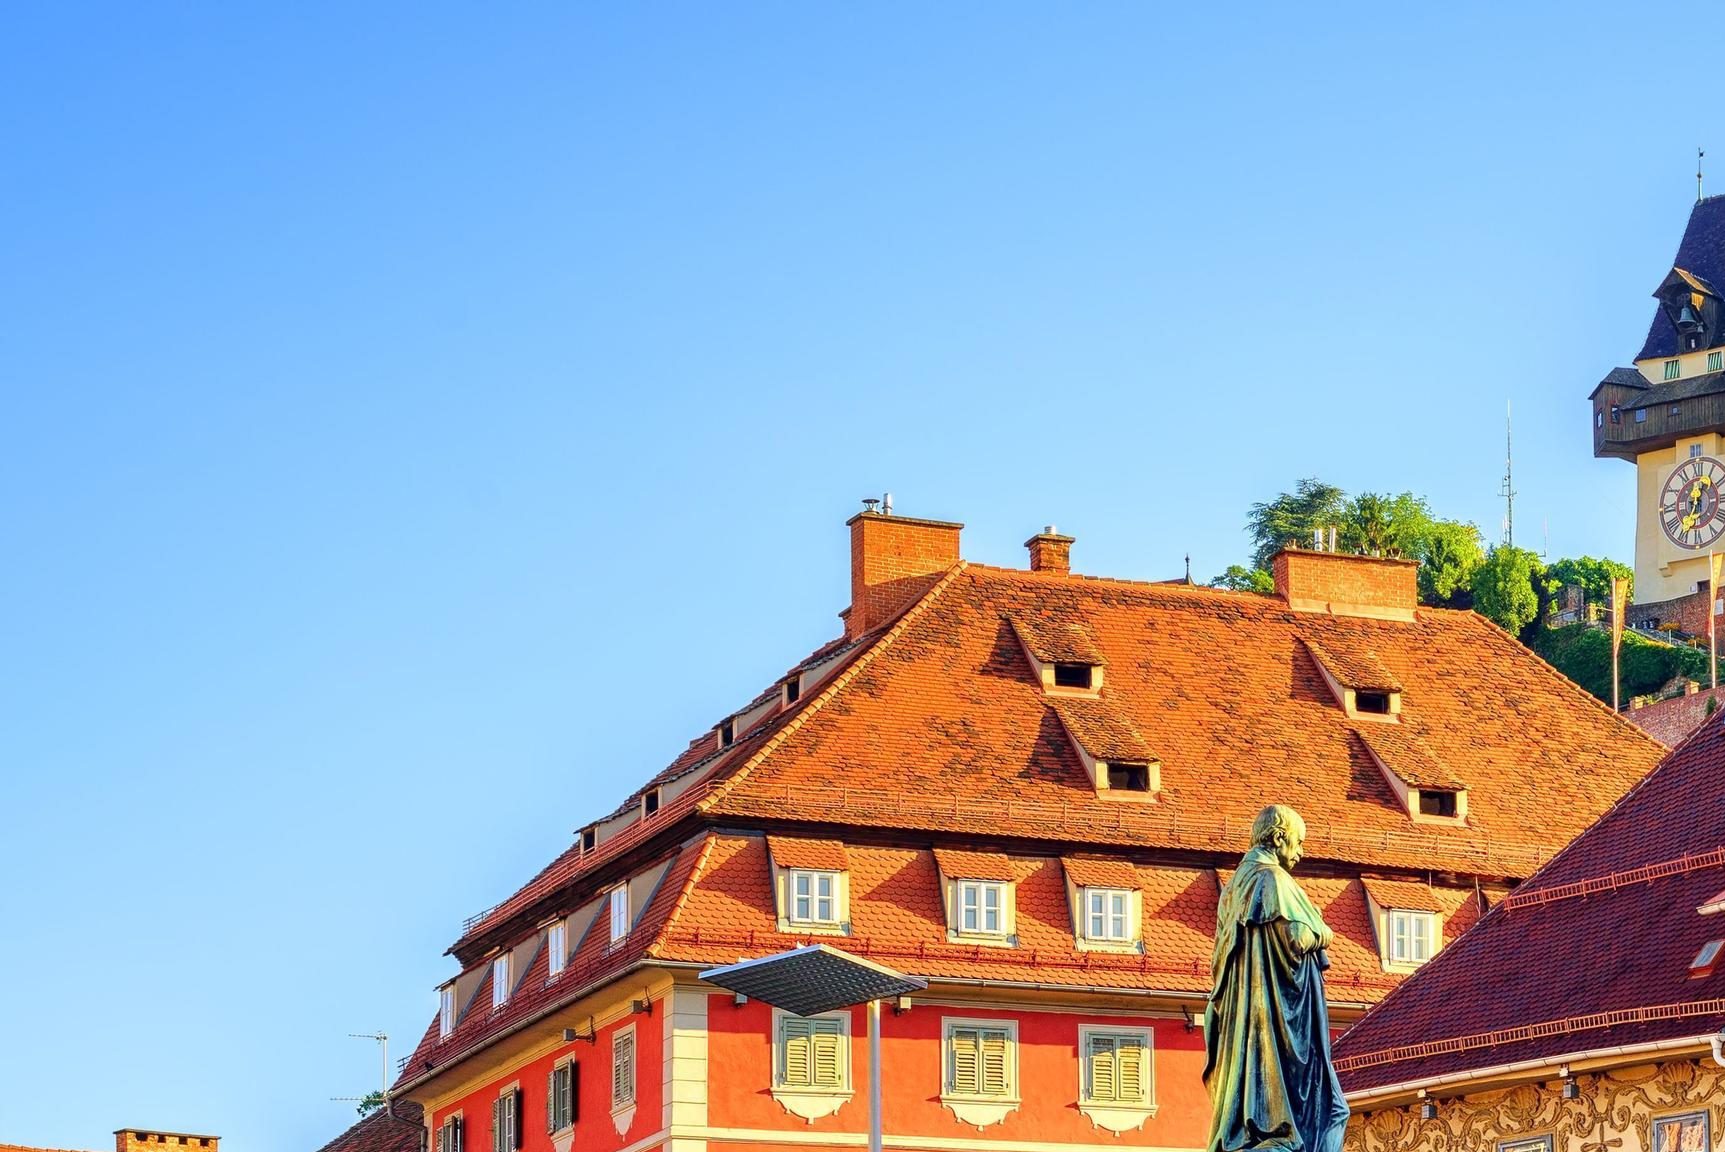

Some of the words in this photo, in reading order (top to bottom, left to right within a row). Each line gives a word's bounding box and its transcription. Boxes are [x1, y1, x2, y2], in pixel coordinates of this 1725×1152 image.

[1691, 462, 1704, 477] XII
[1663, 501, 1677, 514] IX
[1708, 523, 1719, 538] V
